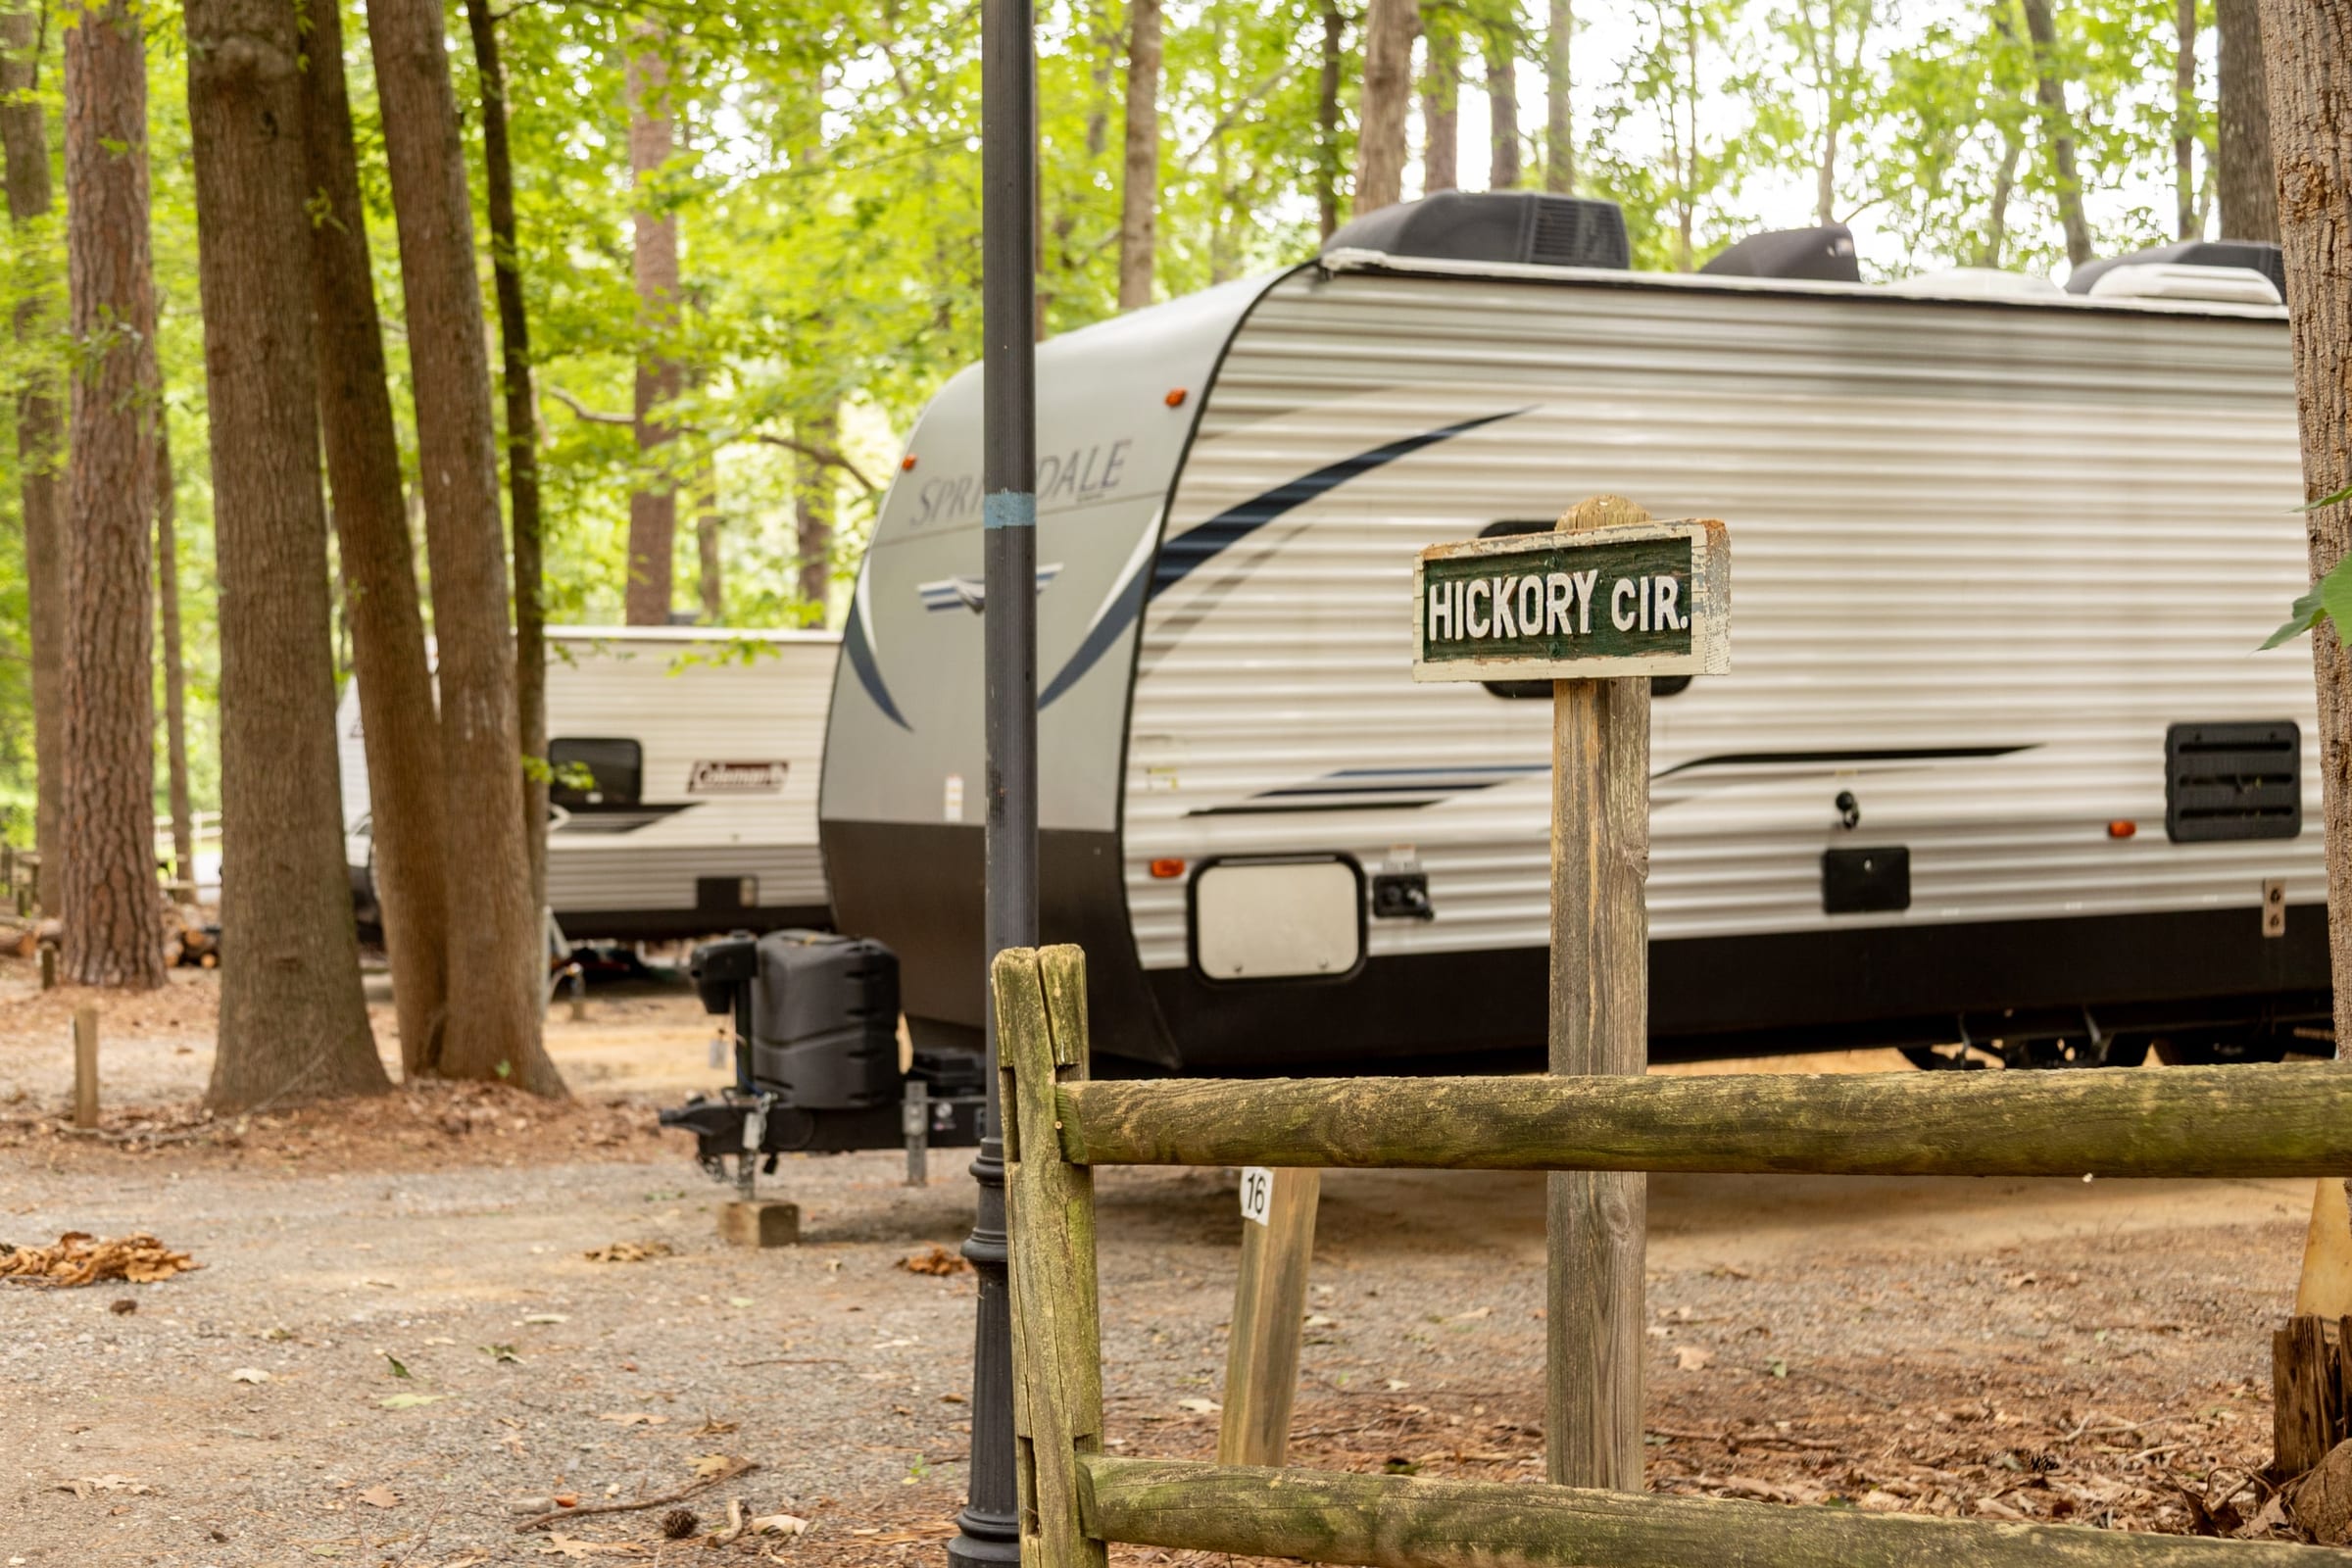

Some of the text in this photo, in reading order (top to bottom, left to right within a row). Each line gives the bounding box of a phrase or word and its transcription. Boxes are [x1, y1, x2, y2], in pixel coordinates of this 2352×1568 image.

[911, 438, 1133, 525] SPRIDALE
[1429, 569, 1689, 641] HICKORY CIR.
[1247, 1172, 1266, 1214] 16
